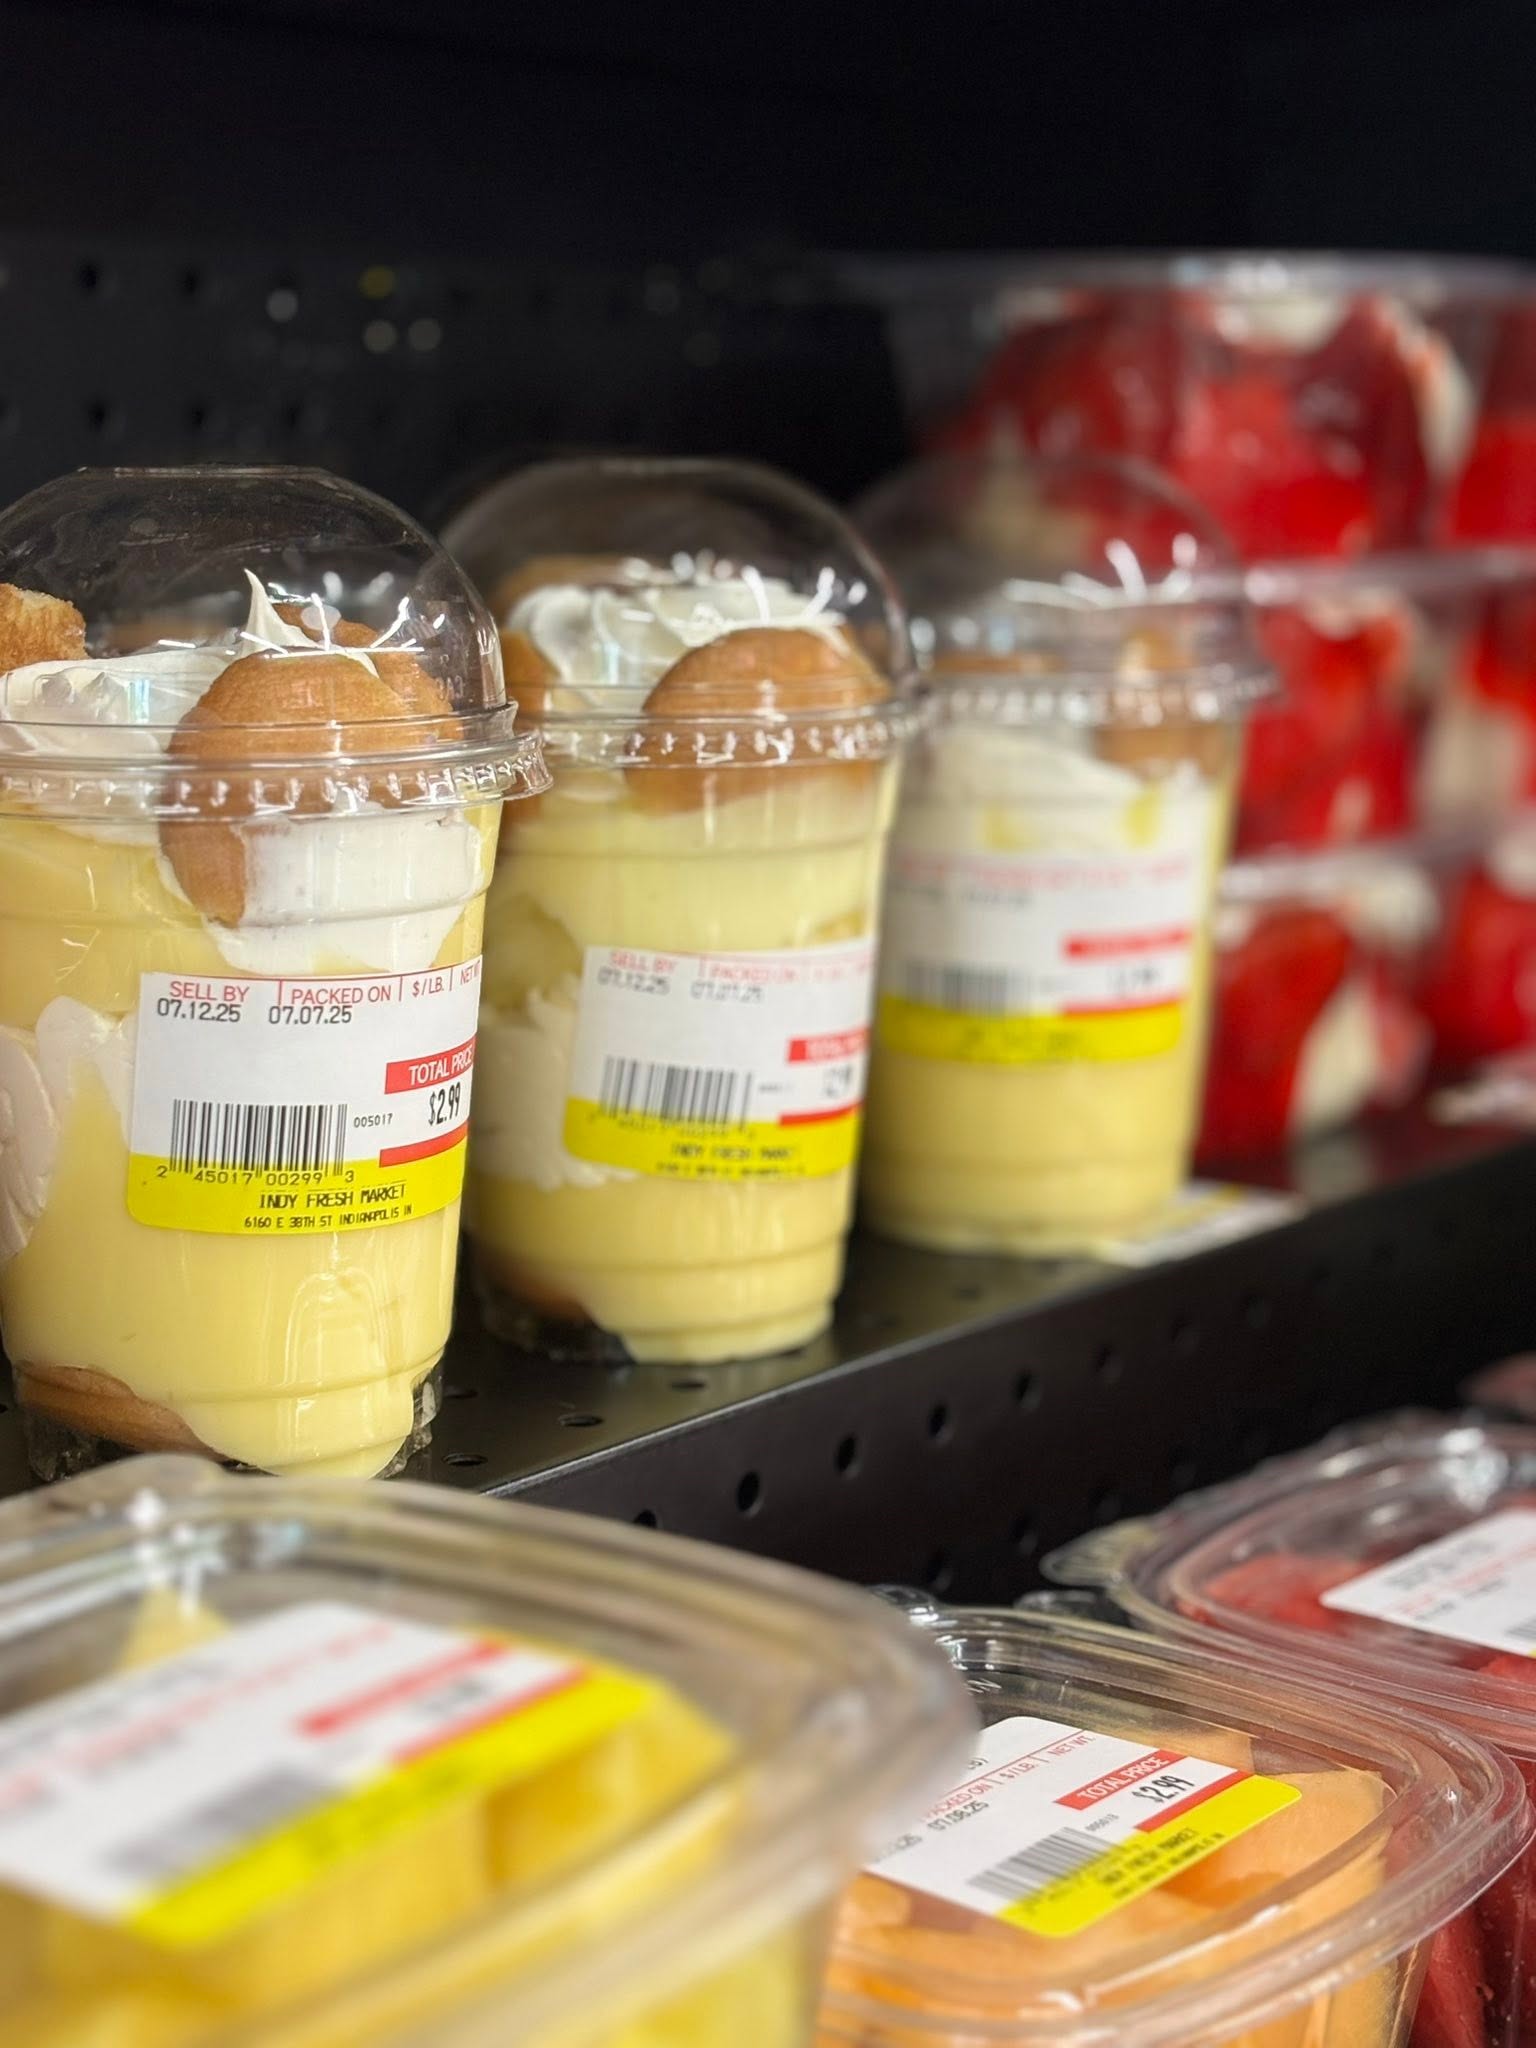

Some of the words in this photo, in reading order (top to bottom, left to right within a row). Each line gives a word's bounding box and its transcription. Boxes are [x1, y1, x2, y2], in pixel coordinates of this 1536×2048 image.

[169, 980, 217, 1001] SELL
[223, 985, 250, 1002] BY
[291, 986, 364, 1005] PACKED
[367, 984, 392, 1003] ON
[156, 997, 242, 1023] 07.12.25
[268, 1004, 353, 1025] 07.07.25
[408, 1057, 450, 1086] TOTAL
[428, 1081, 461, 1127] $2.99
[353, 1112, 394, 1129] 005017
[156, 1165, 168, 1179] 2
[193, 1170, 253, 1185] 45017
[266, 1172, 323, 1186] 00299
[344, 1169, 355, 1184] 3
[259, 1190, 298, 1209] INDY
[306, 1188, 354, 1209] FRESH
[360, 1181, 407, 1205] MARKET
[244, 1216, 272, 1229] 6160
[276, 1216, 284, 1229] E
[289, 1215, 315, 1228] 38TH
[319, 1213, 332, 1227] ST
[338, 1206, 400, 1226] INDIANAPOLIS
[403, 1203, 413, 1216] IN
[1046, 1742, 1076, 1757] NET
[1076, 1774, 1131, 1801] TOTAL
[1122, 1756, 1170, 1783] PRICE
[1131, 1774, 1195, 1804] $2.99
